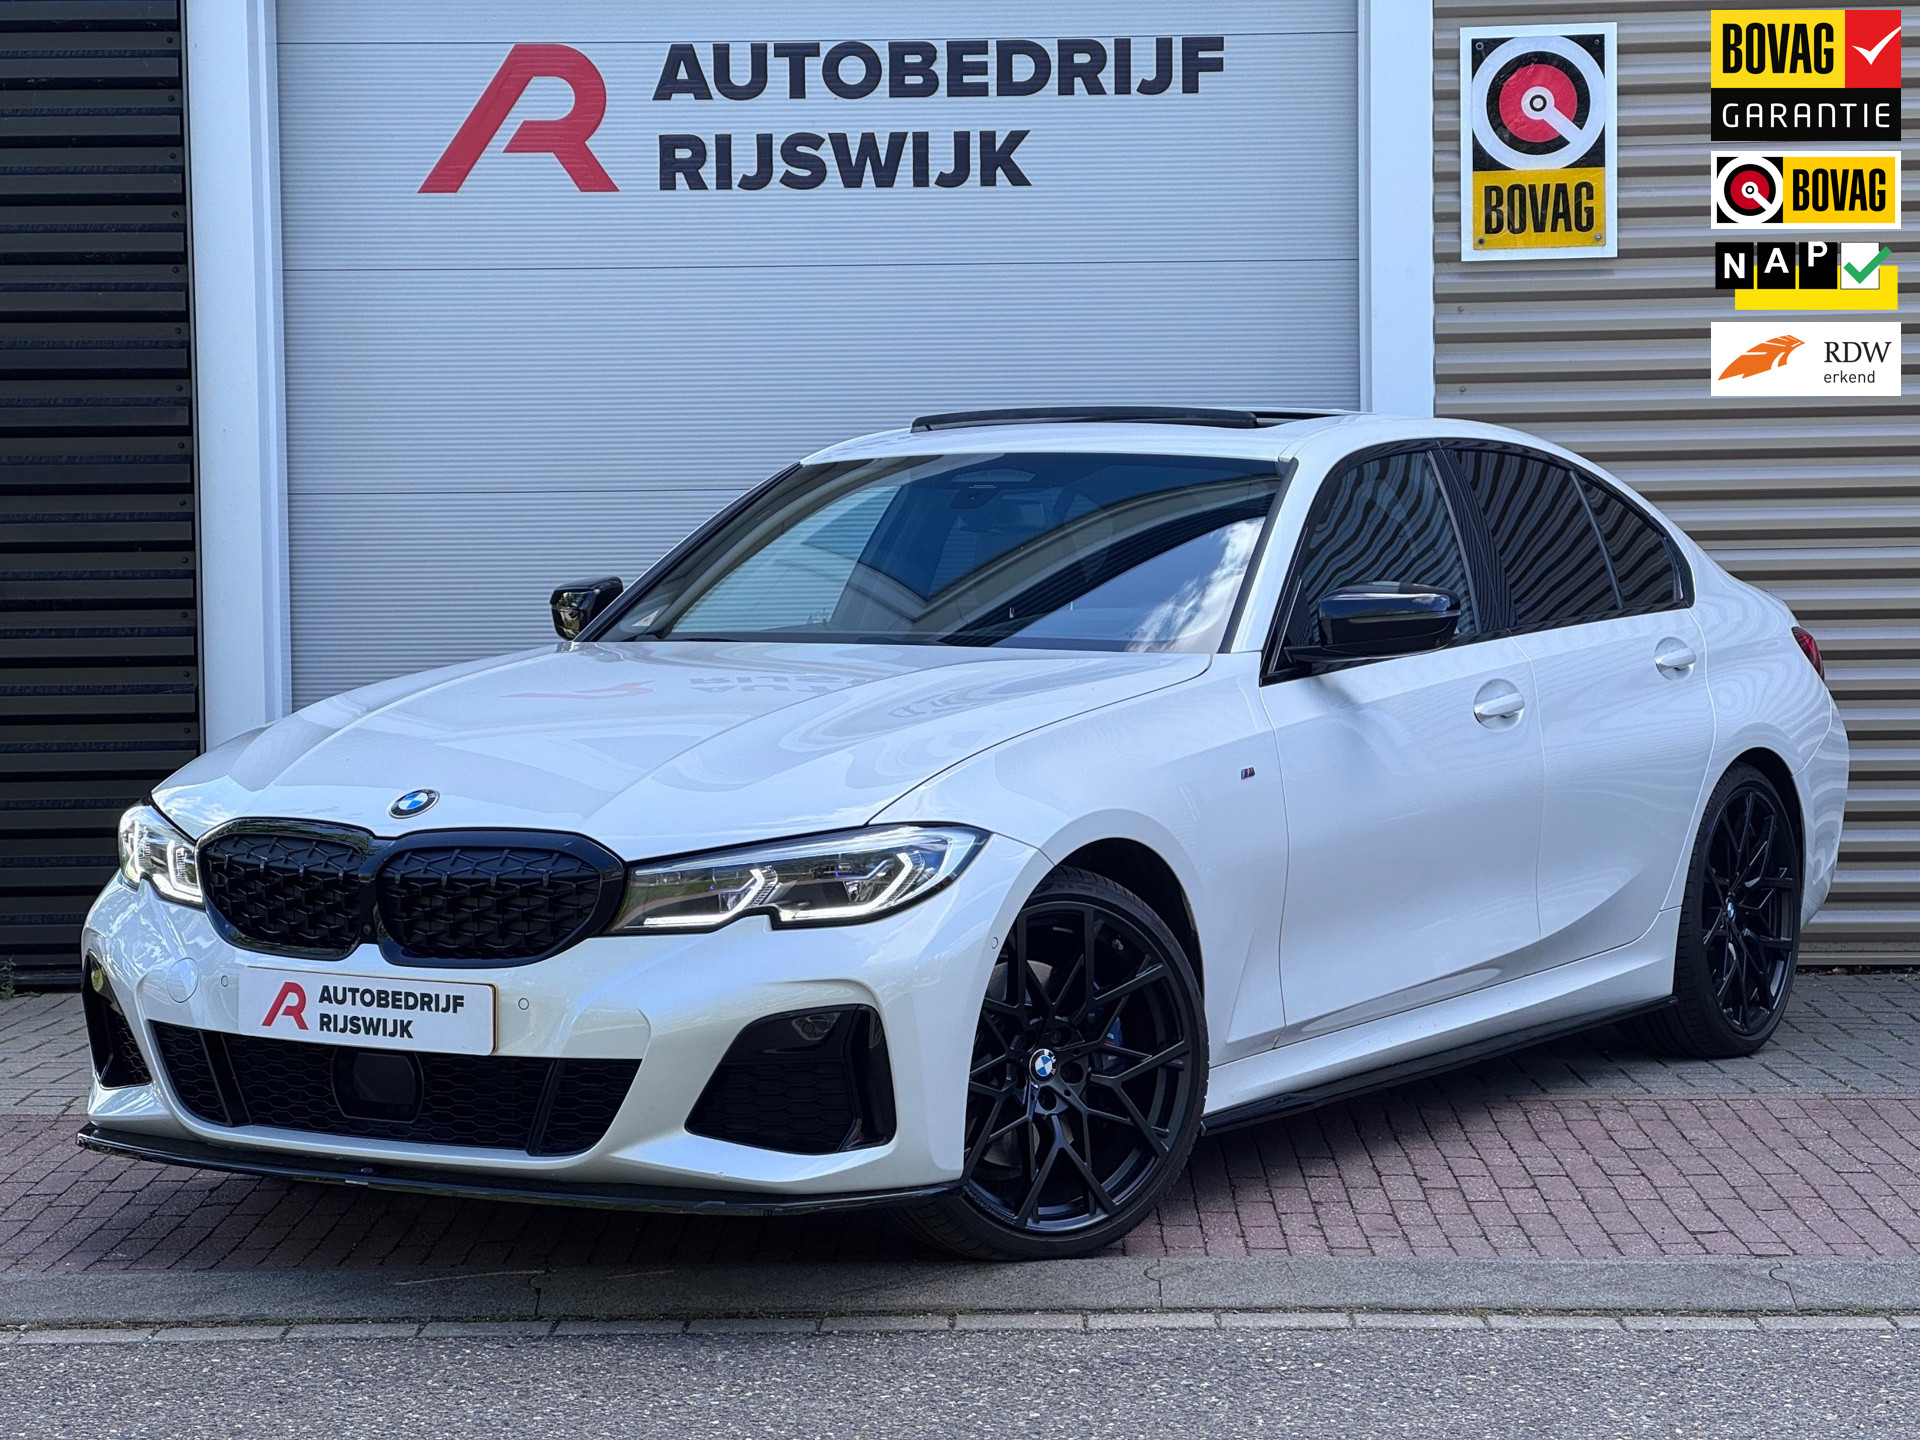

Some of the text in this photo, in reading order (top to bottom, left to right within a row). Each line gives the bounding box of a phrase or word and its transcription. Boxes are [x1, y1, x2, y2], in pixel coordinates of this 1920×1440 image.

[652, 36, 1225, 101] AUTOBEDRIJF
[658, 129, 1032, 191] RIJSWIJK
[1484, 181, 1595, 235] BOVAG
[318, 984, 465, 1015] AUTOBEDRIJF
[318, 1013, 414, 1039] RIJSWIJK
